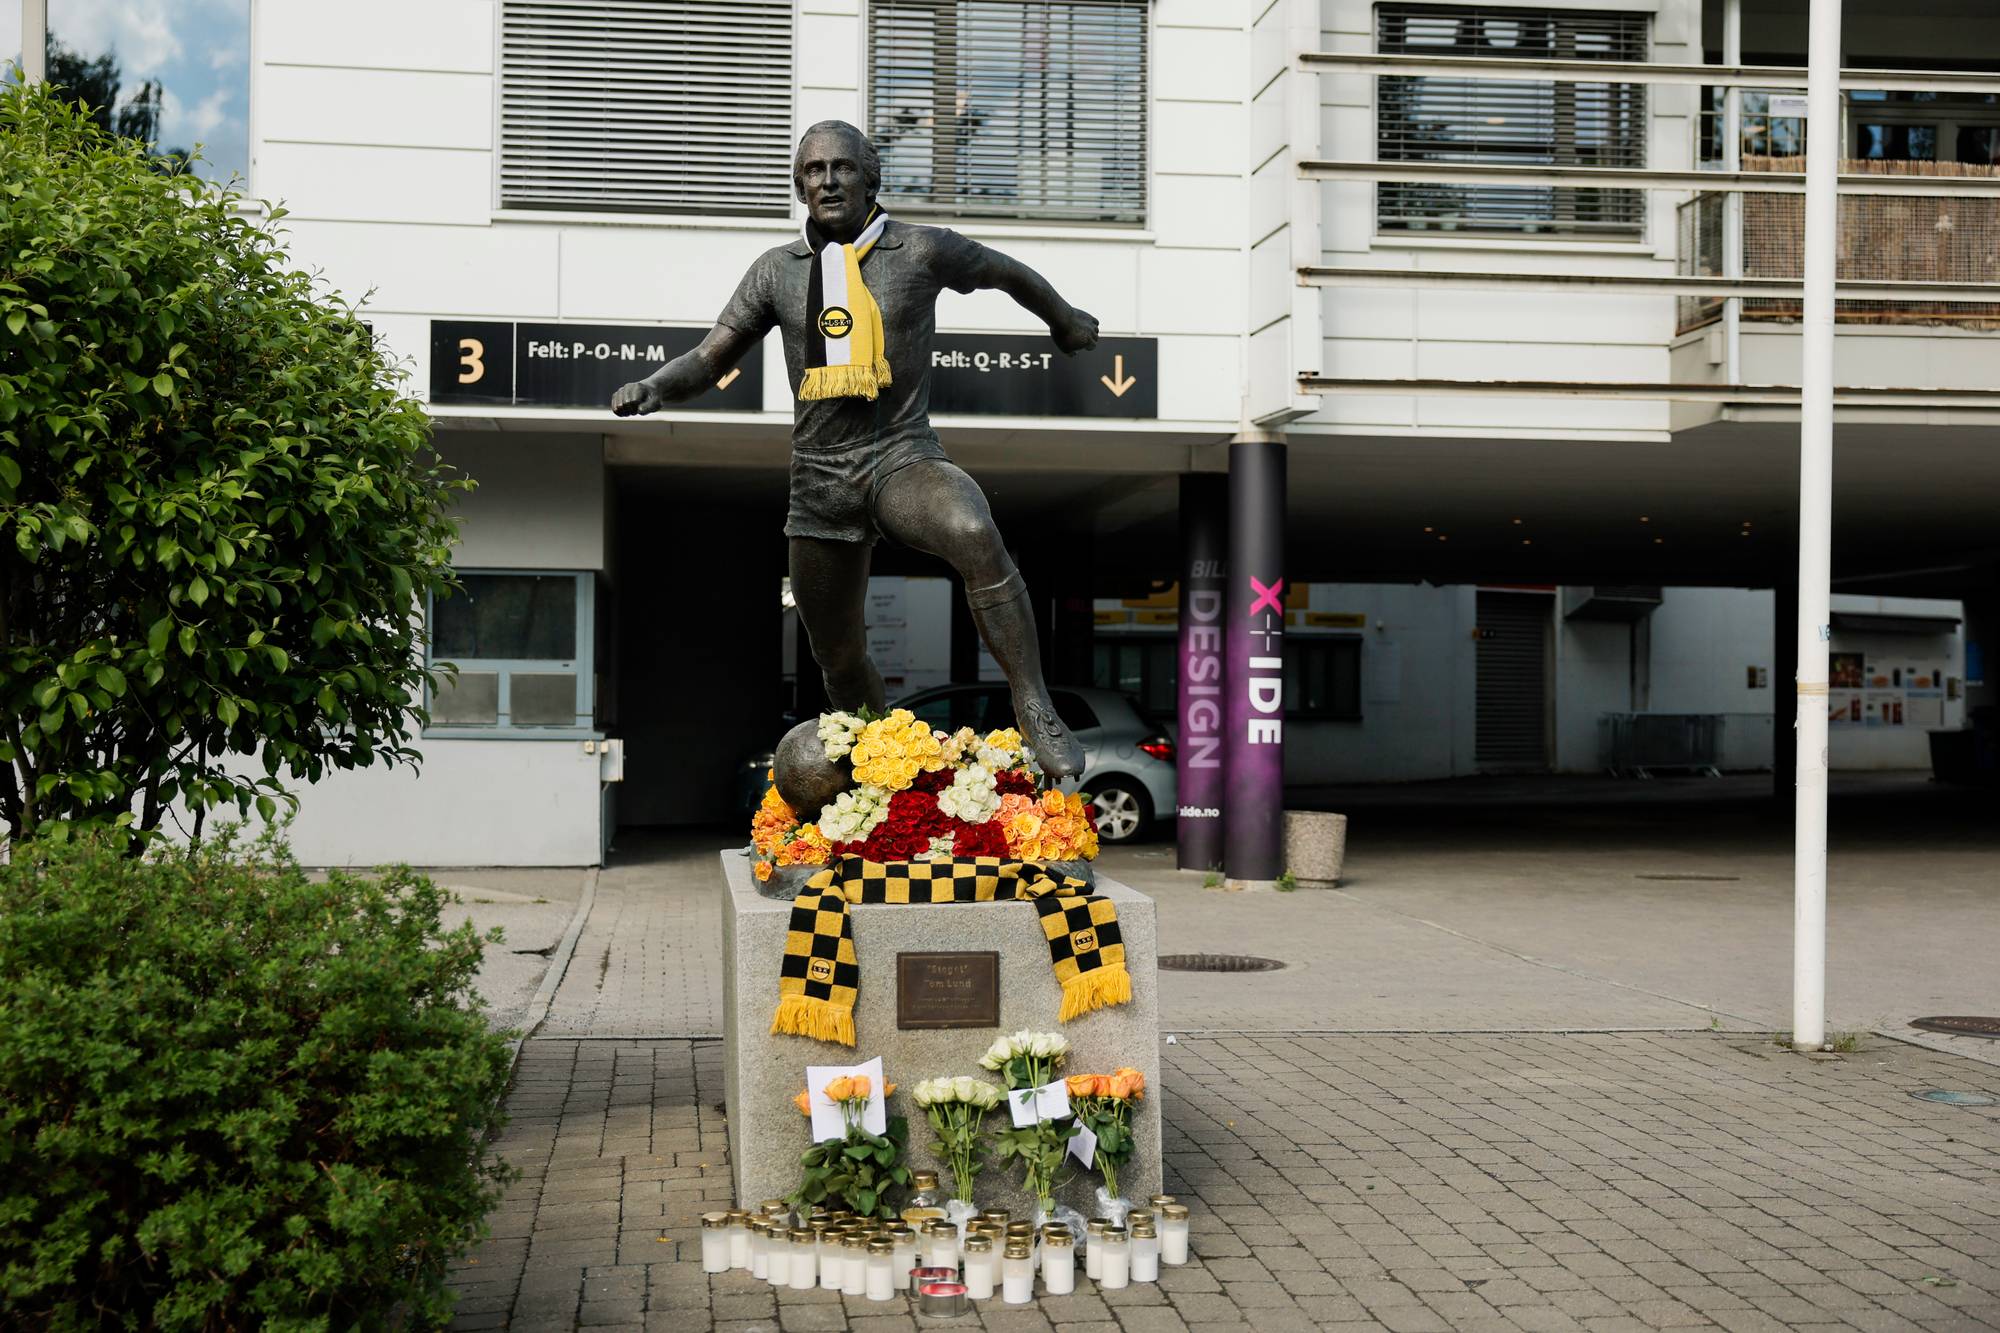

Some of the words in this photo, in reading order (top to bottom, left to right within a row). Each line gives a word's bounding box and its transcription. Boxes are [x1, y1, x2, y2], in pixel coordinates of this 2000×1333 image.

[458, 338, 484, 384] 3
[528, 340, 568, 359] Felt:
[573, 342, 665, 361] P-O-N-M
[931, 350, 970, 368] Felt:
[974, 351, 1052, 372] Q-R-S-T
[1191, 560, 1226, 578] BIL
[1188, 590, 1220, 768] DESIGN
